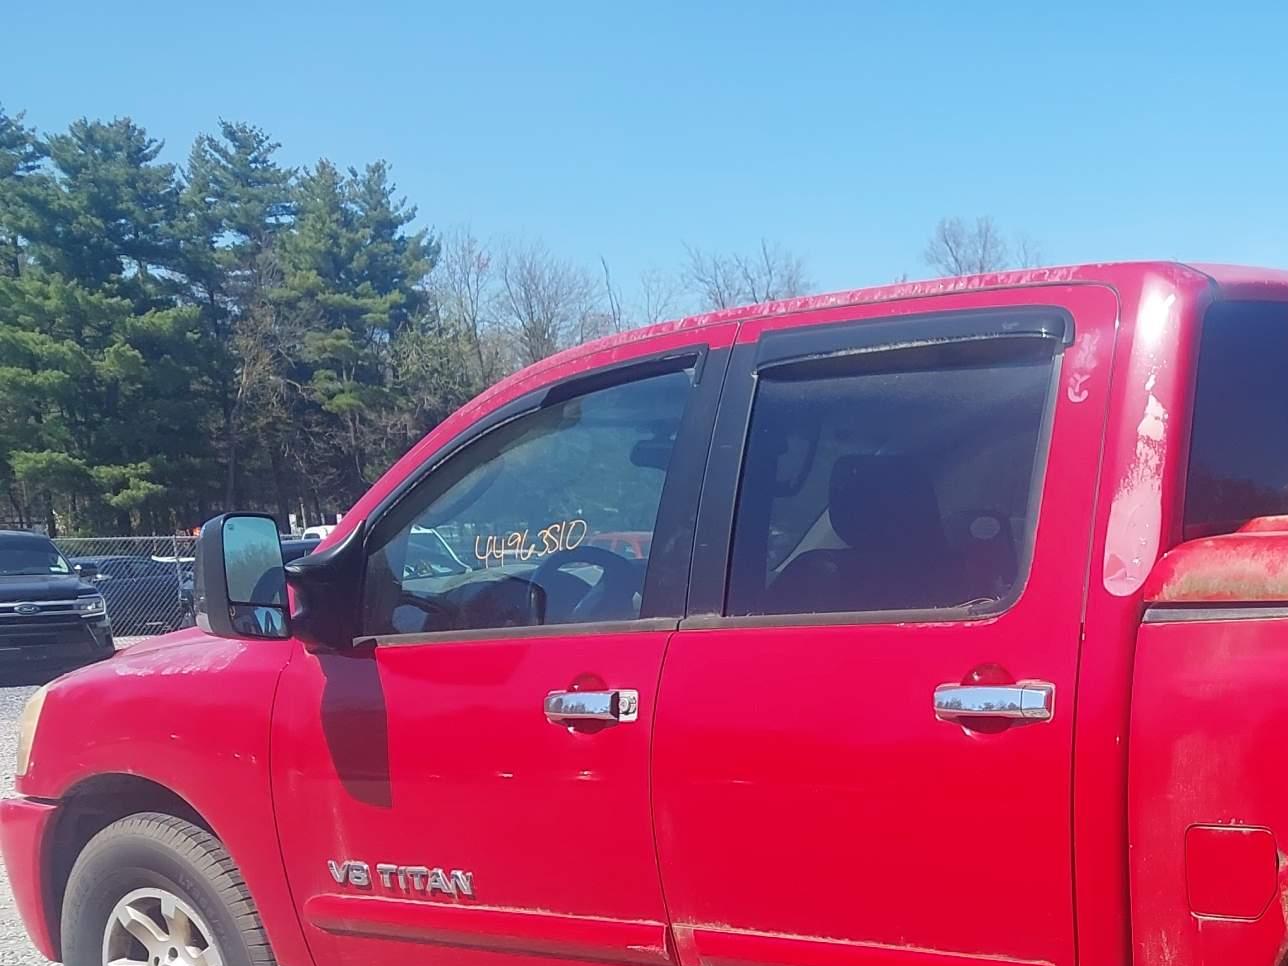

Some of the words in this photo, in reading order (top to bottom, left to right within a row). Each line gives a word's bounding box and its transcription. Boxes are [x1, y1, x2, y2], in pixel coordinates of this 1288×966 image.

[475, 519, 587, 569] 44963510
[327, 859, 372, 887] V8
[376, 863, 473, 896] TITAN
